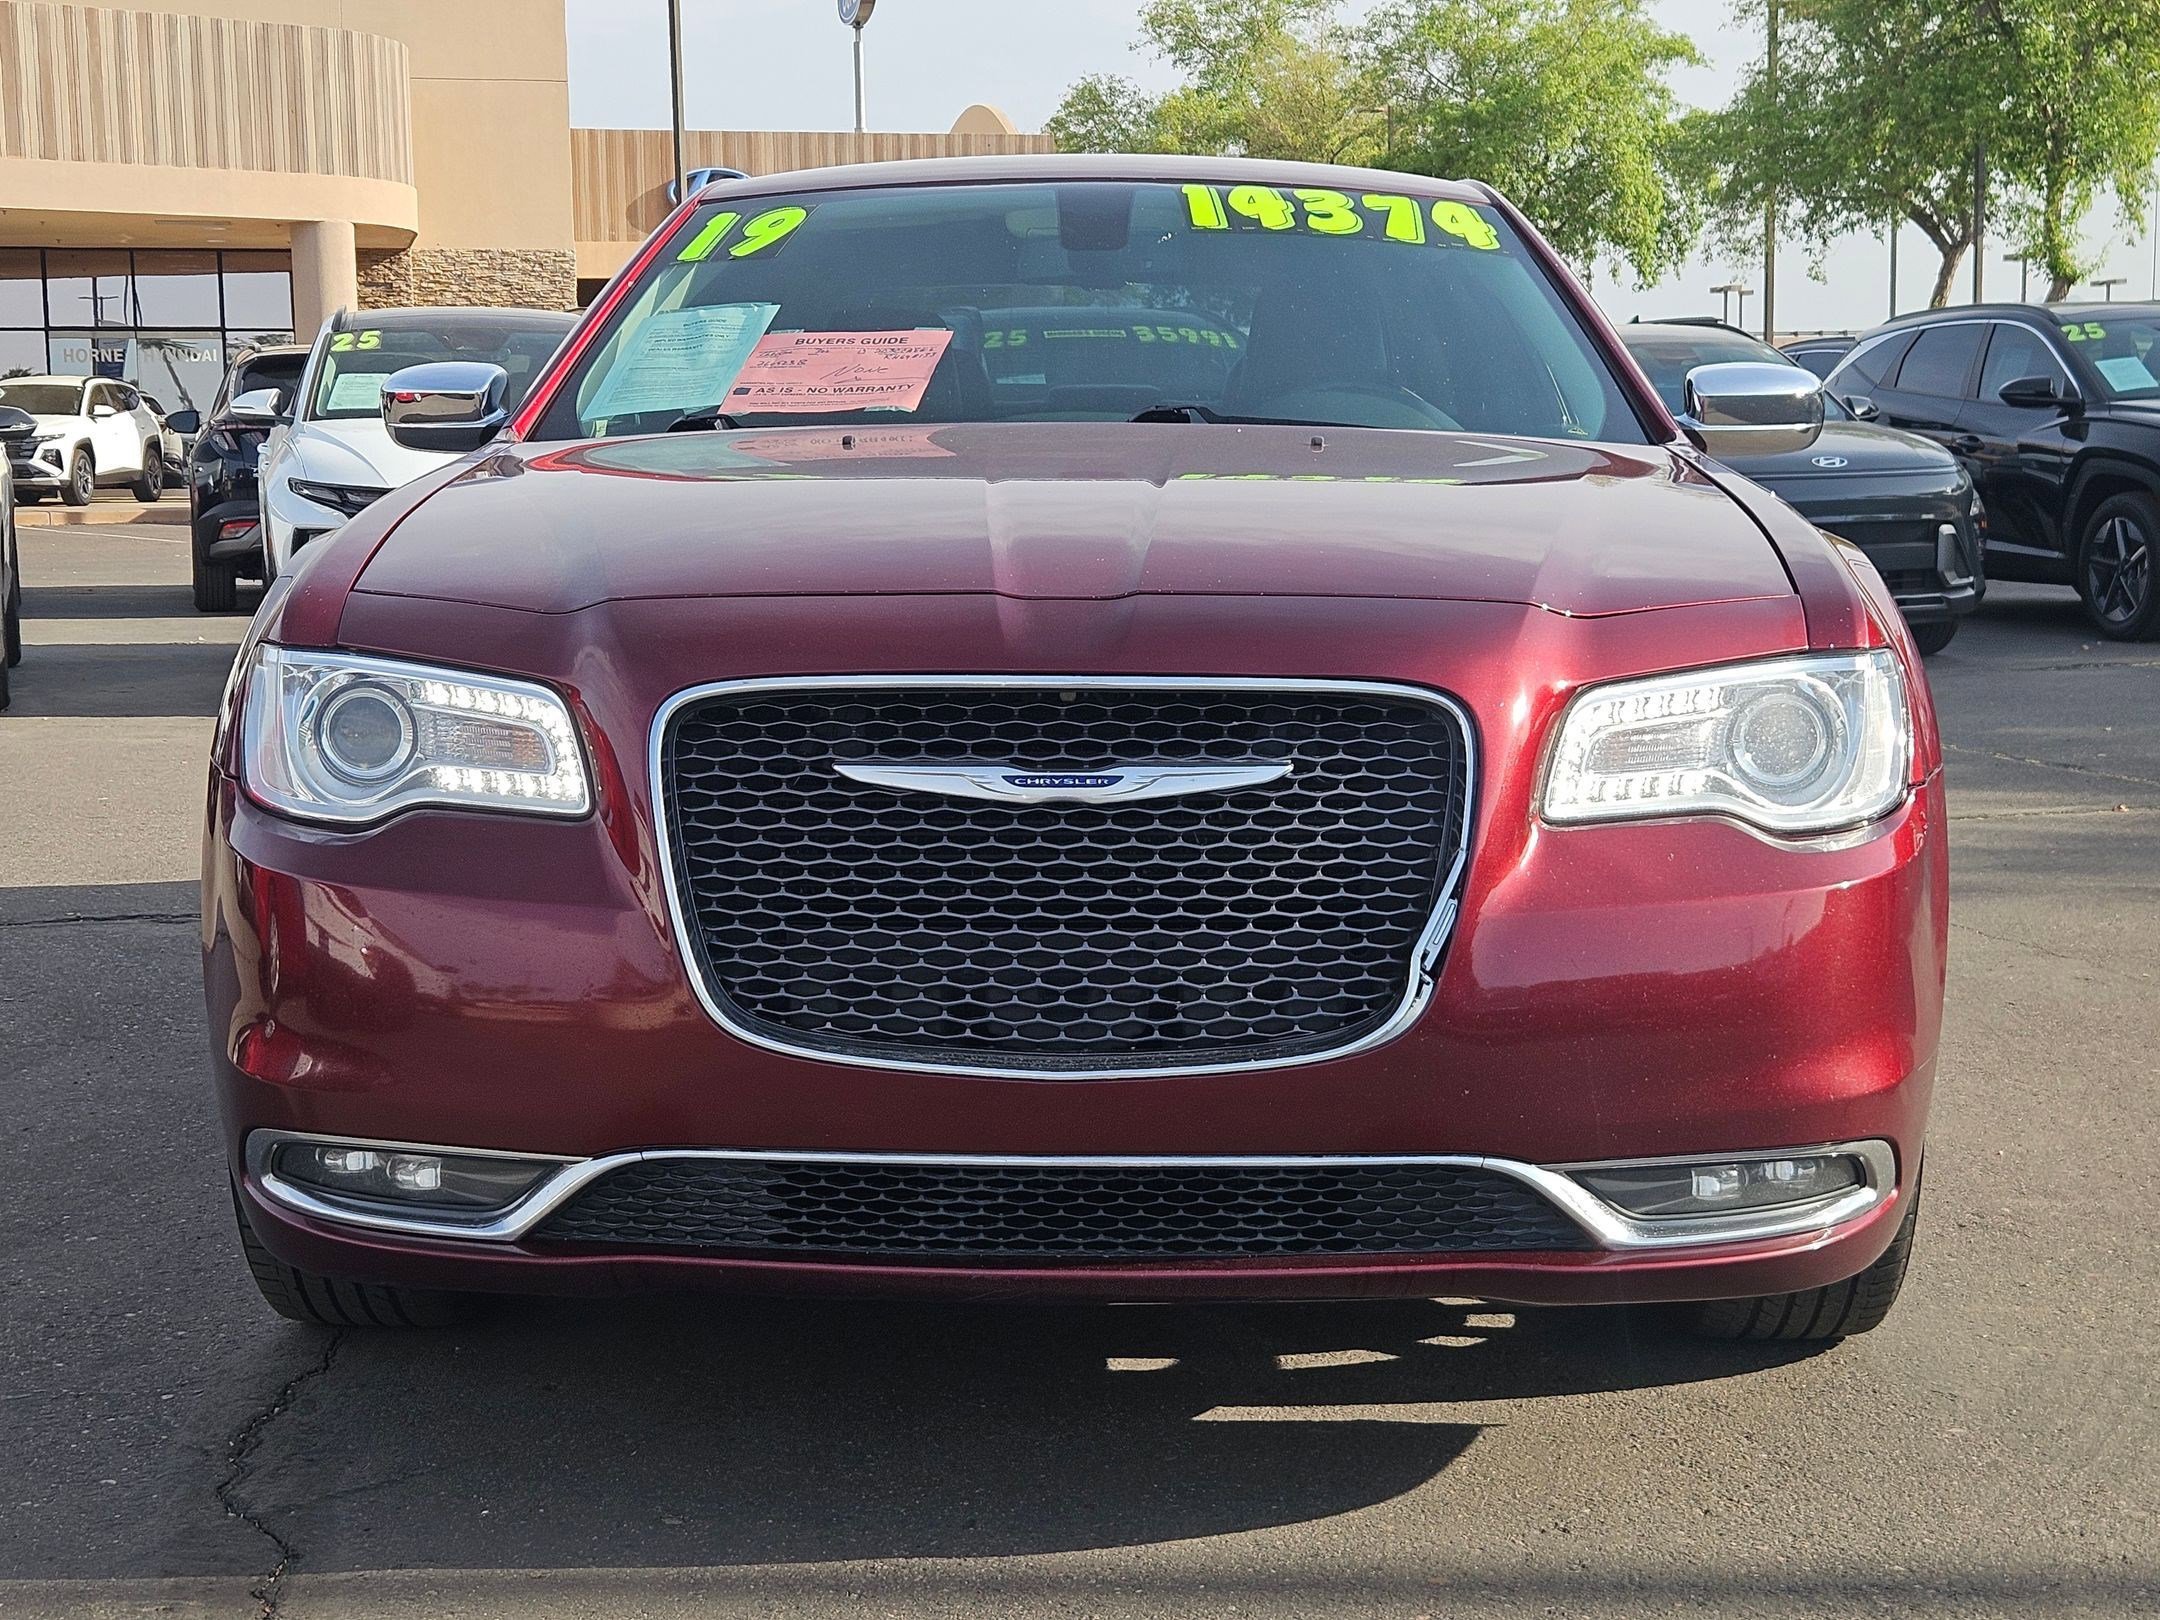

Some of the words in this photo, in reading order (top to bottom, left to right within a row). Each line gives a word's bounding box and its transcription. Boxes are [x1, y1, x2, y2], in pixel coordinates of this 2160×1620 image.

[1182, 184, 1501, 250] 14374
[677, 207, 807, 261] 19
[330, 330, 382, 353] 25
[794, 337, 856, 346] BUYERS
[860, 336, 910, 345] GUIDE
[984, 329, 1027, 348] 25
[1132, 326, 1237, 349] 35991
[2060, 322, 2106, 342] 25
[63, 348, 125, 363] HORNE
[143, 348, 218, 363] HYUNDAI
[806, 386, 829, 394] NO
[832, 383, 916, 394] WARRANTY
